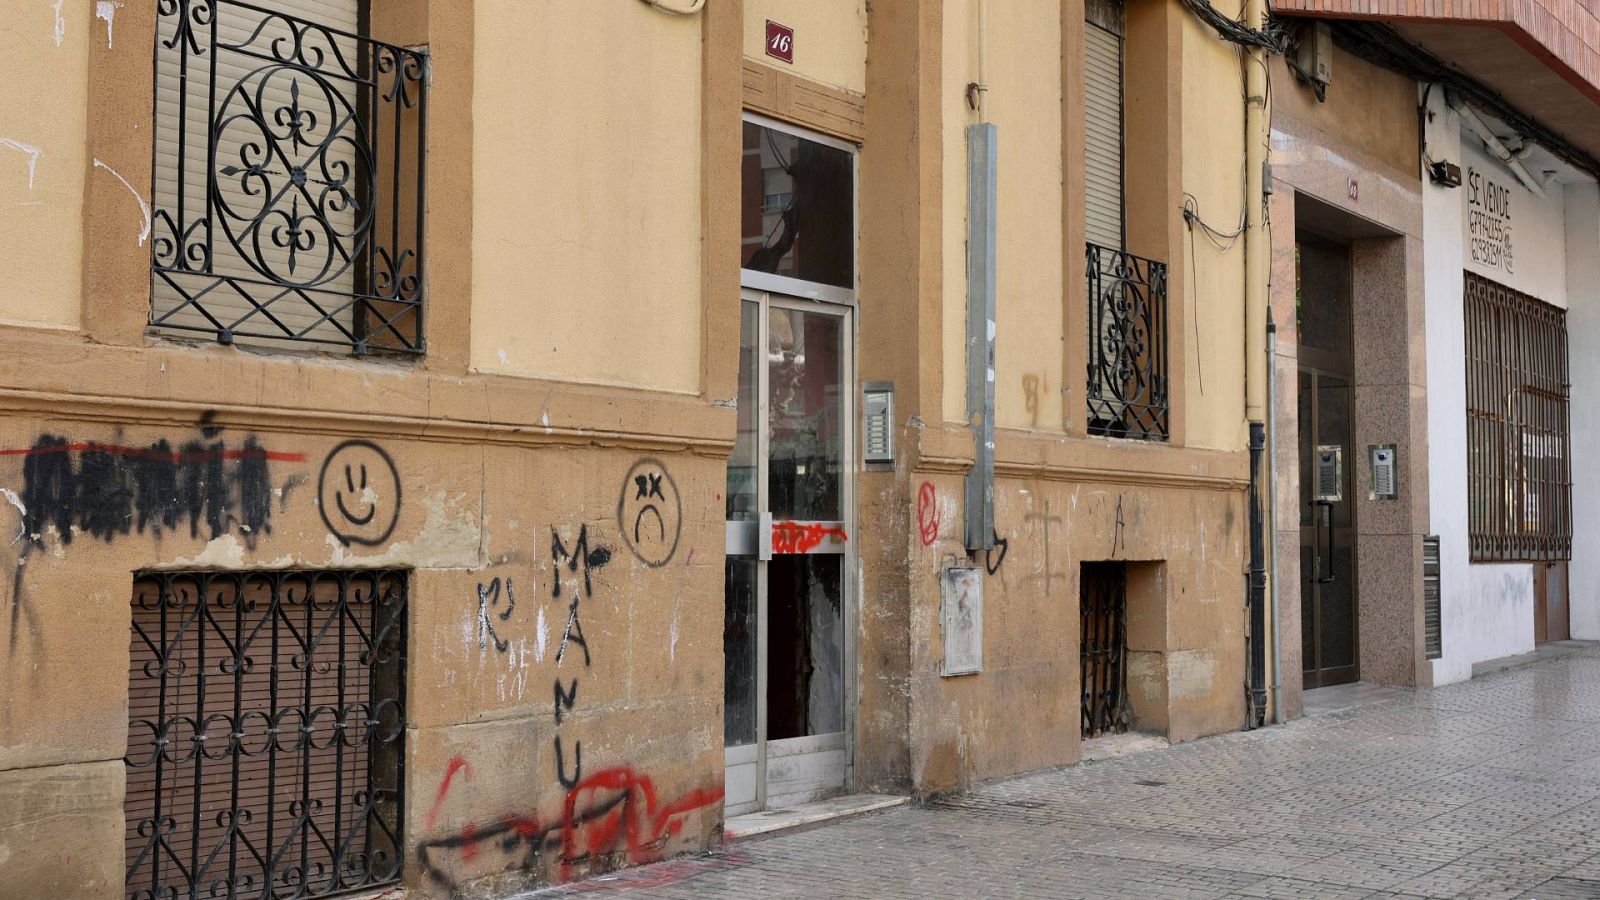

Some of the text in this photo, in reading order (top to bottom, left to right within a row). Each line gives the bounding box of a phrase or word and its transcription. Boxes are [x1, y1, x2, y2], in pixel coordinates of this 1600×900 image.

[771, 33, 791, 53] 16
[1469, 170, 1510, 220] SE VENDE
